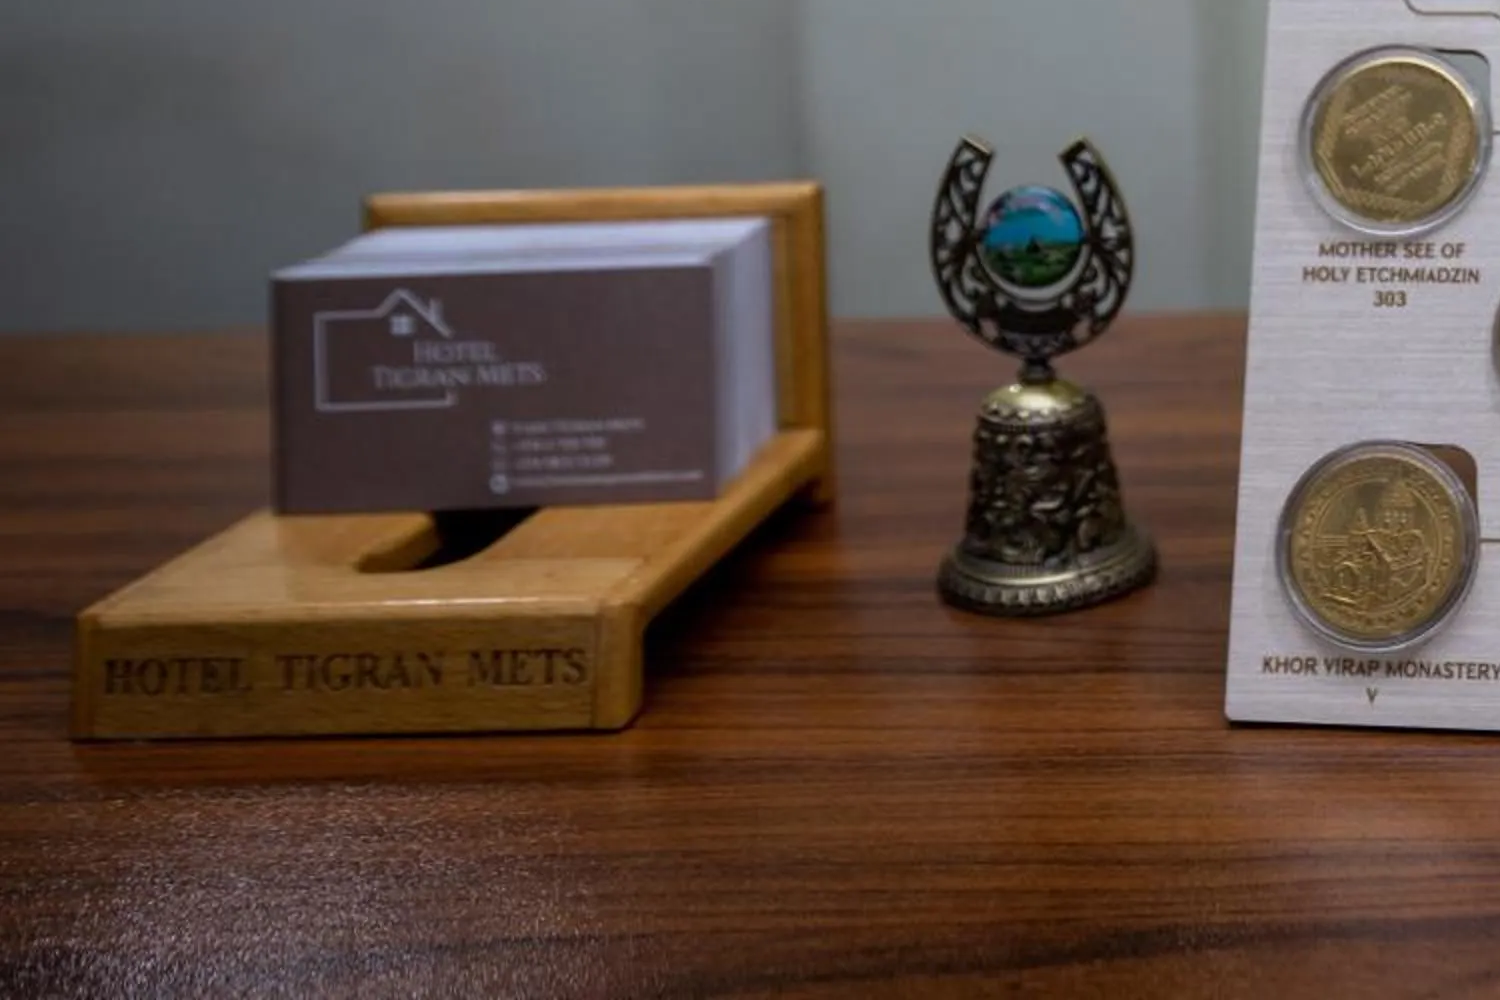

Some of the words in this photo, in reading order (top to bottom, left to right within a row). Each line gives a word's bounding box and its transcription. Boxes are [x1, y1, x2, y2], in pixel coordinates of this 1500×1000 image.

[1319, 241, 1398, 260] MOTHER
[1403, 241, 1435, 259] SEE
[1441, 241, 1466, 259] OF
[1303, 266, 1350, 284] HOLY
[1356, 266, 1480, 284] ETCHMIADZIN
[1373, 291, 1407, 308] 303
[413, 340, 500, 363] HOTEL
[372, 364, 471, 390] TIGRAN
[477, 362, 548, 385] METS
[104, 656, 254, 696] HOTEL
[275, 649, 442, 692] TIGRAN
[467, 646, 590, 687] METS
[1262, 656, 1319, 674] KHOR
[1324, 658, 1381, 677] VIRAP
[1366, 688, 1378, 704] V
